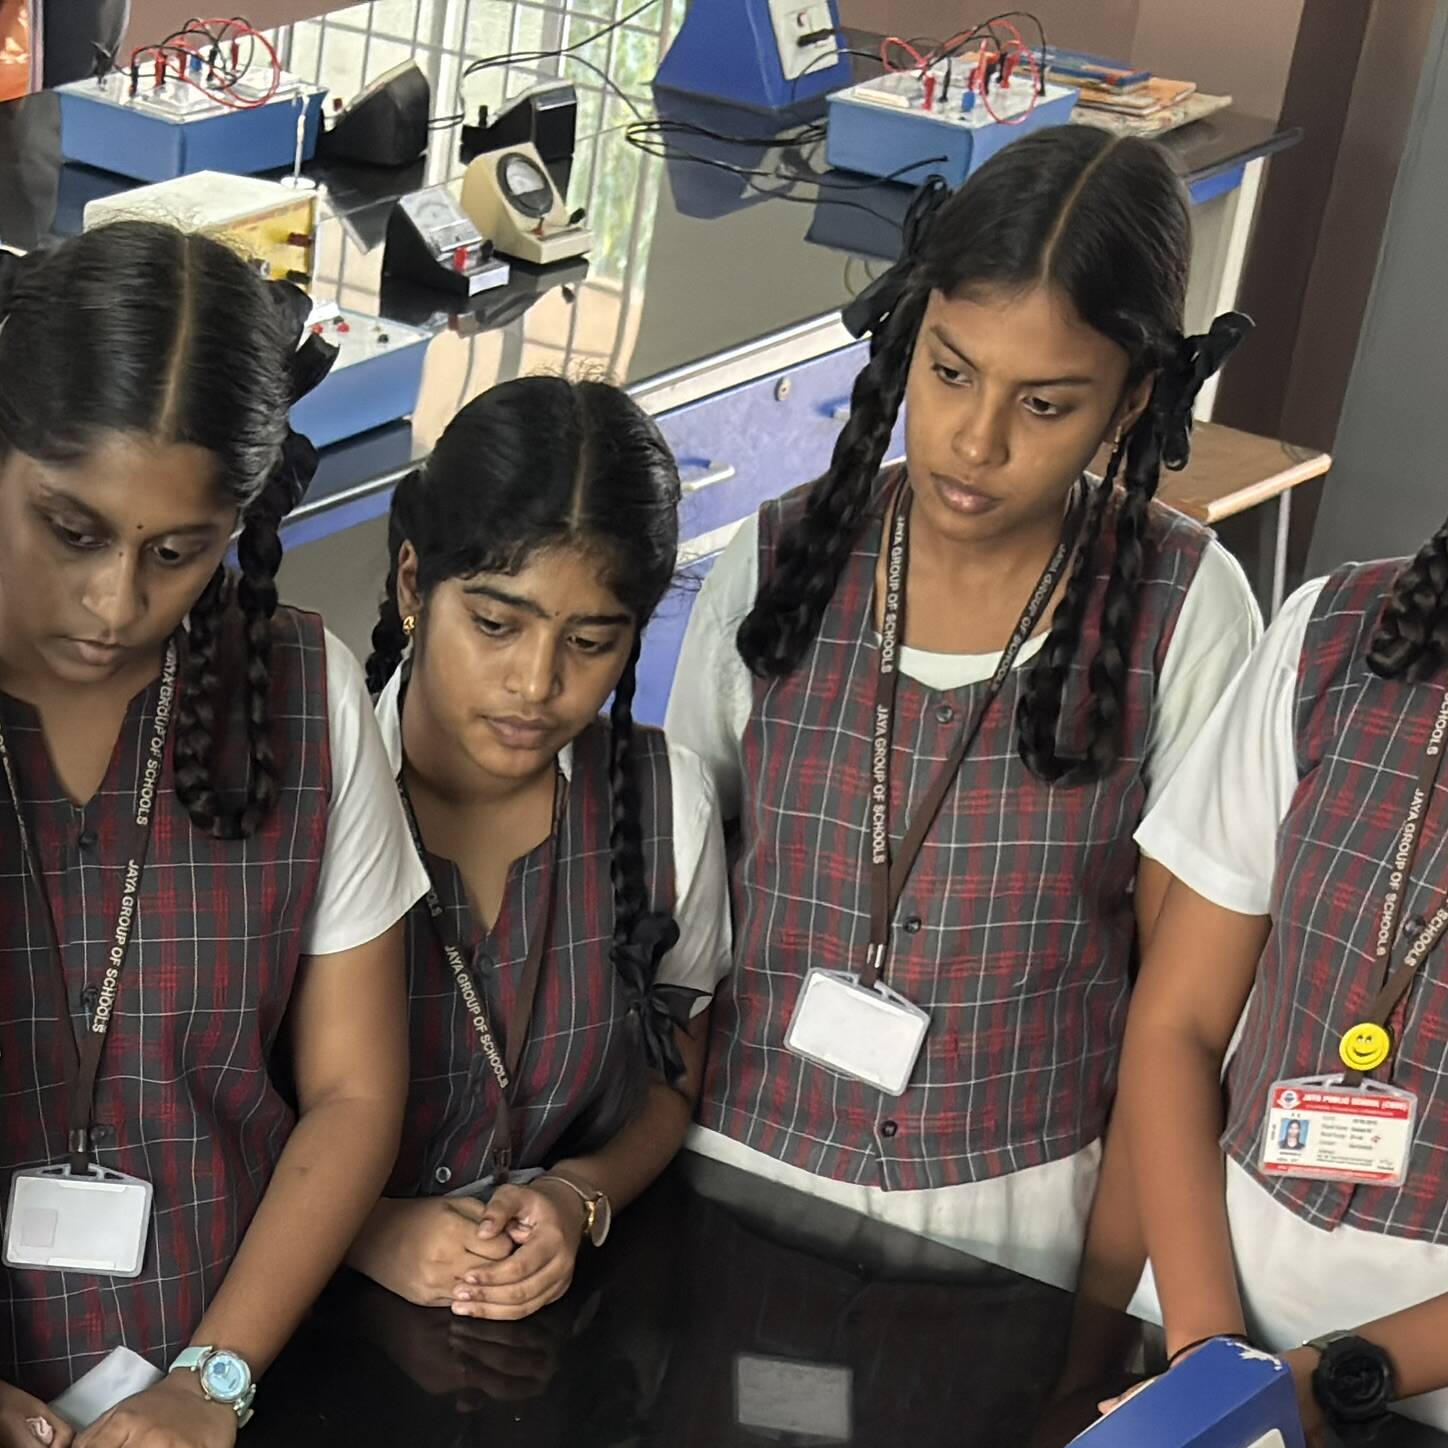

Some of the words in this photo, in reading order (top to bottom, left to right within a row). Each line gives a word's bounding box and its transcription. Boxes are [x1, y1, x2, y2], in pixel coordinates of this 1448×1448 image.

[888, 545, 903, 593] GROUP
[886, 592, 898, 616] OF
[880, 614, 896, 674] SCHOOLS
[153, 684, 172, 736] GROUP
[877, 704, 888, 738] JAYA
[149, 736, 162, 759] OF
[873, 737, 887, 786] GROUP
[136, 758, 159, 826] SCHOOLS
[872, 785, 884, 809] OF
[1406, 788, 1425, 827] JAYA
[871, 808, 885, 865] SCHOOLS
[1393, 821, 1417, 873] GROUP
[123, 858, 137, 895] JAYA
[1388, 869, 1404, 893] OF
[115, 893, 134, 947] GROUP
[1376, 890, 1398, 957] SCHOOLS
[110, 943, 122, 968] OF
[444, 943, 465, 976] JAYA
[92, 964, 118, 1034] SCHOOLS
[455, 973, 481, 1017] GROUP
[473, 1014, 488, 1036] OF
[480, 1032, 509, 1090] SCHOOLS
